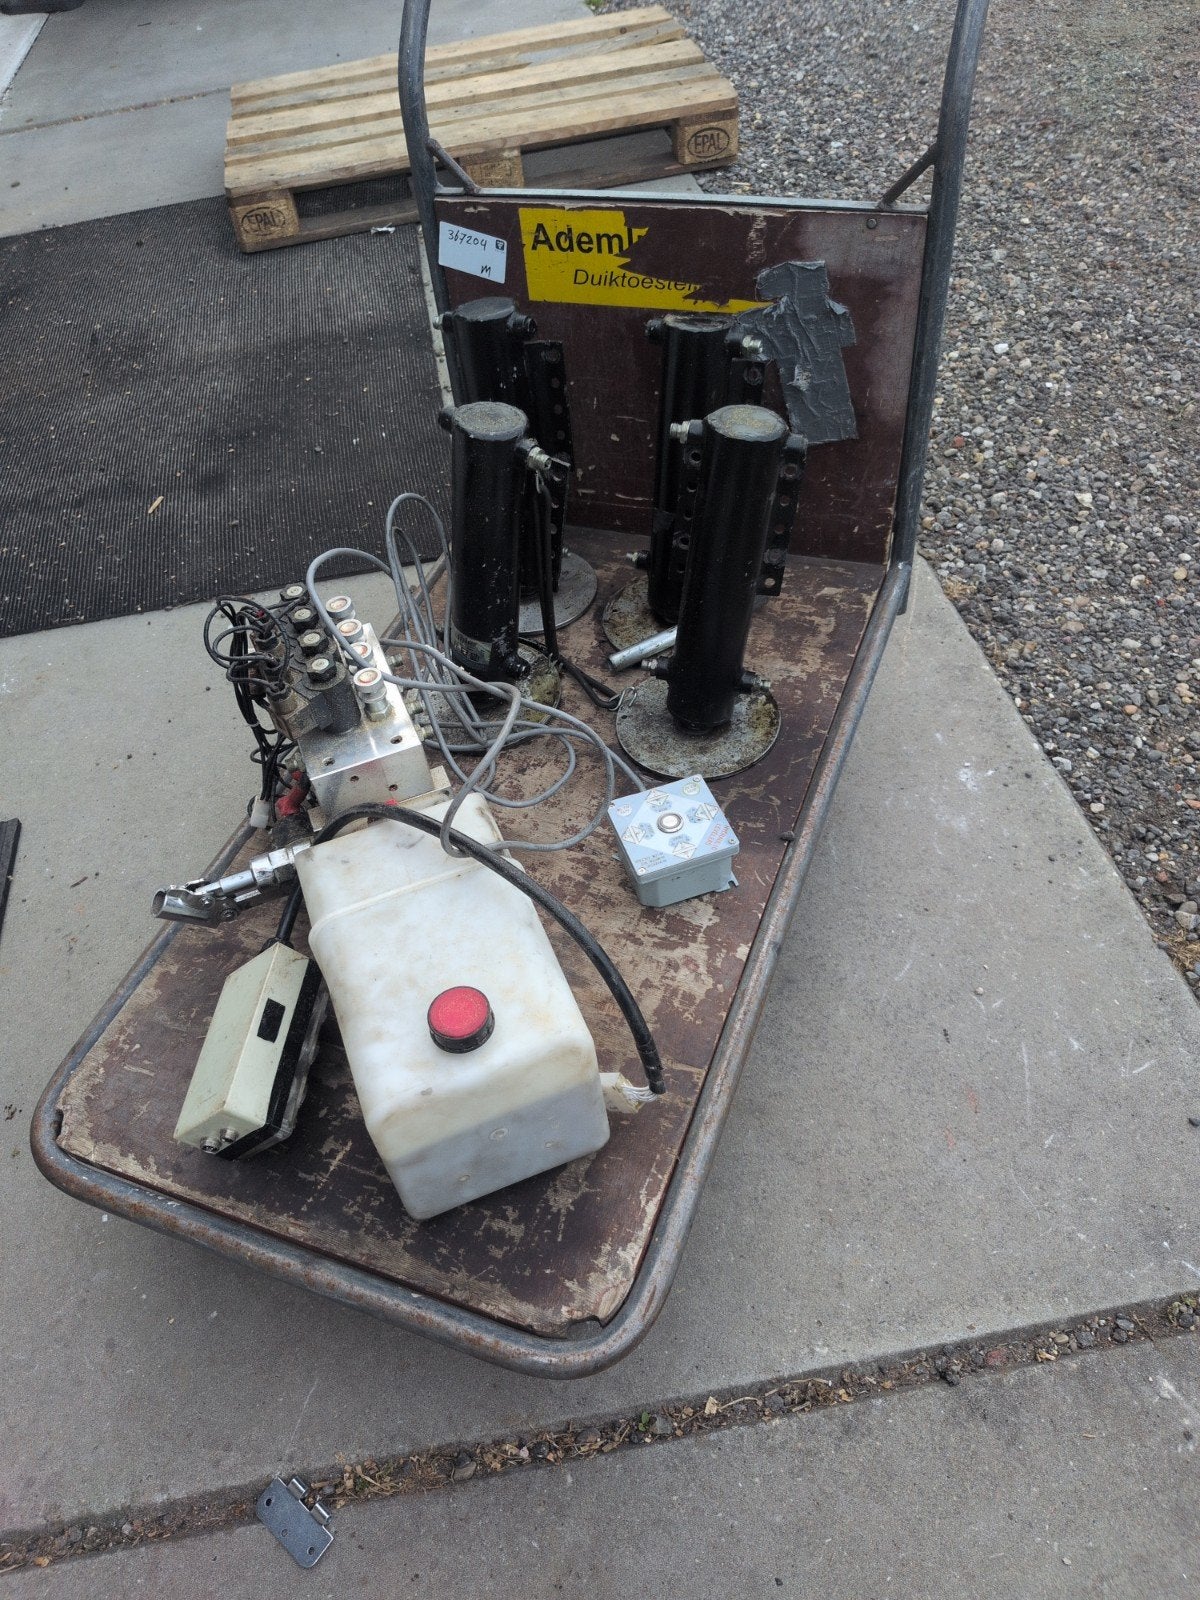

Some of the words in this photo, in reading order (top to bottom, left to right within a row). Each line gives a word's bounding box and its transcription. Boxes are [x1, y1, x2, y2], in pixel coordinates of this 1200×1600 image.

[694, 132, 723, 154] EPAL
[246, 209, 279, 232] EPAL
[448, 228, 488, 251] 367204
[531, 222, 644, 254] Ademl
